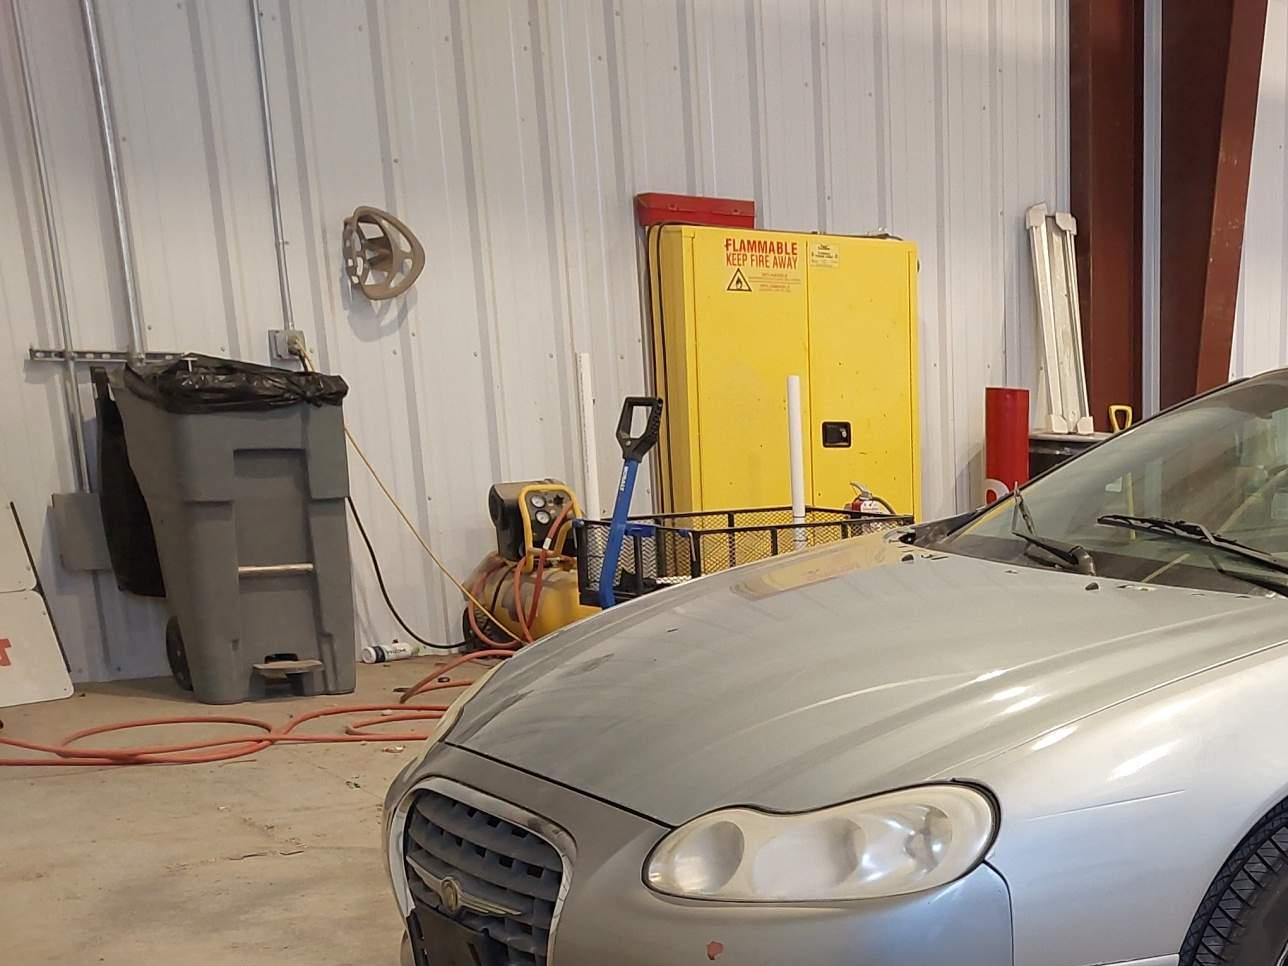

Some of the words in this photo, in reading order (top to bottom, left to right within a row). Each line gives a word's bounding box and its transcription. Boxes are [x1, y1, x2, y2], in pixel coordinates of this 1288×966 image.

[725, 238, 798, 256] FLAMMABLE
[726, 252, 748, 267] KEEP
[750, 254, 770, 269] FIRE
[772, 255, 798, 270] AWAY
